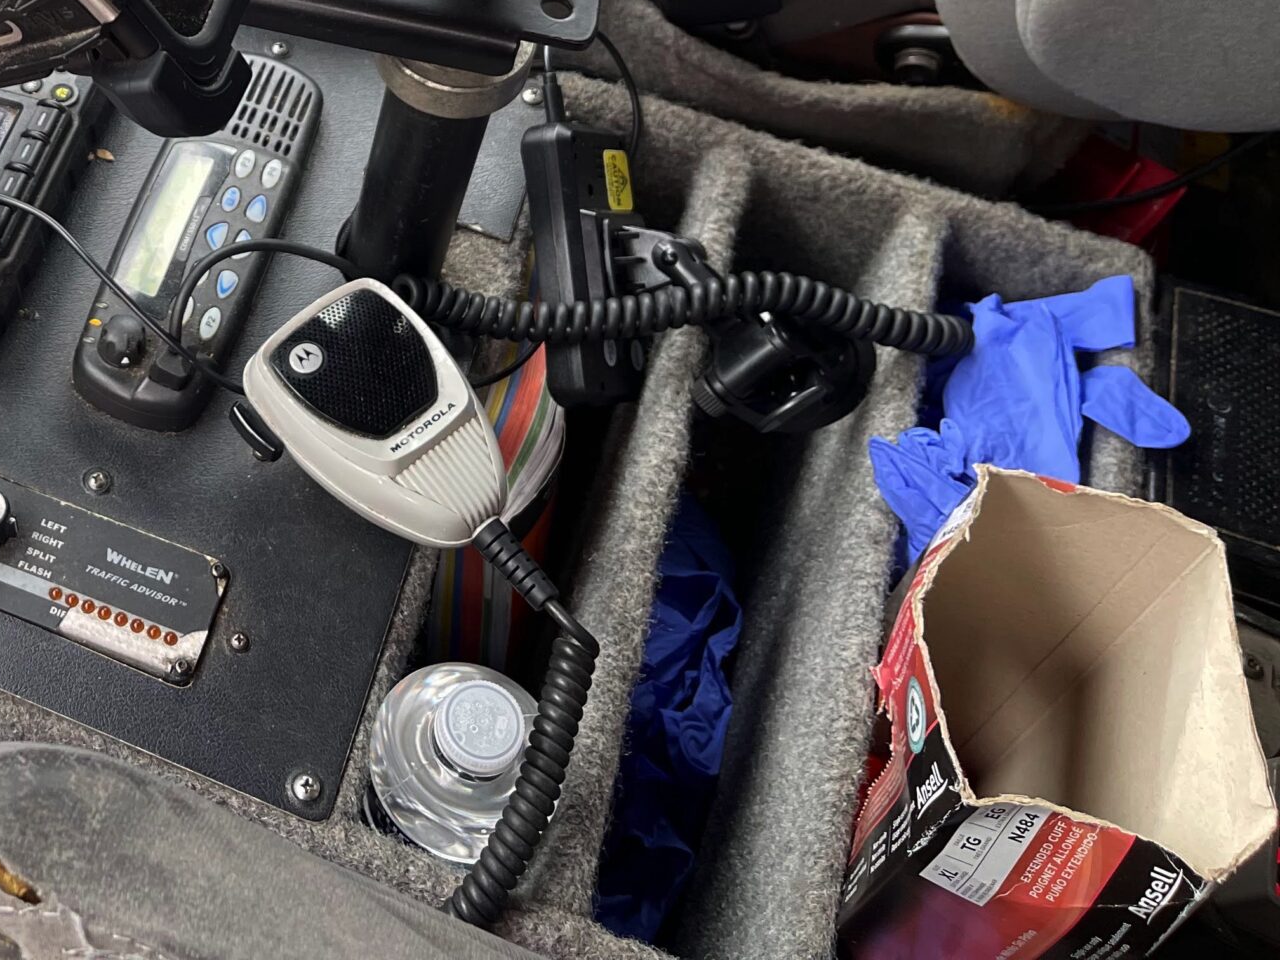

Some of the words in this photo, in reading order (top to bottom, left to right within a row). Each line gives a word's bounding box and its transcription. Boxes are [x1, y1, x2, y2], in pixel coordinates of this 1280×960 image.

[390, 402, 456, 453] MOTOROLA
[41, 518, 67, 534] LEFT
[31, 531, 64, 549] RIGHT
[26, 547, 56, 564] SPLIT
[17, 560, 52, 579] FLASH
[85, 565, 130, 588] TRAFFIC
[916, 761, 944, 809] Ansell
[985, 807, 1006, 820] EG
[1008, 812, 1040, 843] N484
[961, 836, 981, 852] TG
[1021, 842, 1053, 883] EXTENDED
[1048, 821, 1067, 843] CUFF
[938, 868, 958, 882] XL
[1046, 878, 1067, 902] PUÑO
[1066, 832, 1098, 880] EXTENDIDO
[1029, 864, 1058, 899] POIGNET
[1128, 866, 1177, 919] Ansell
